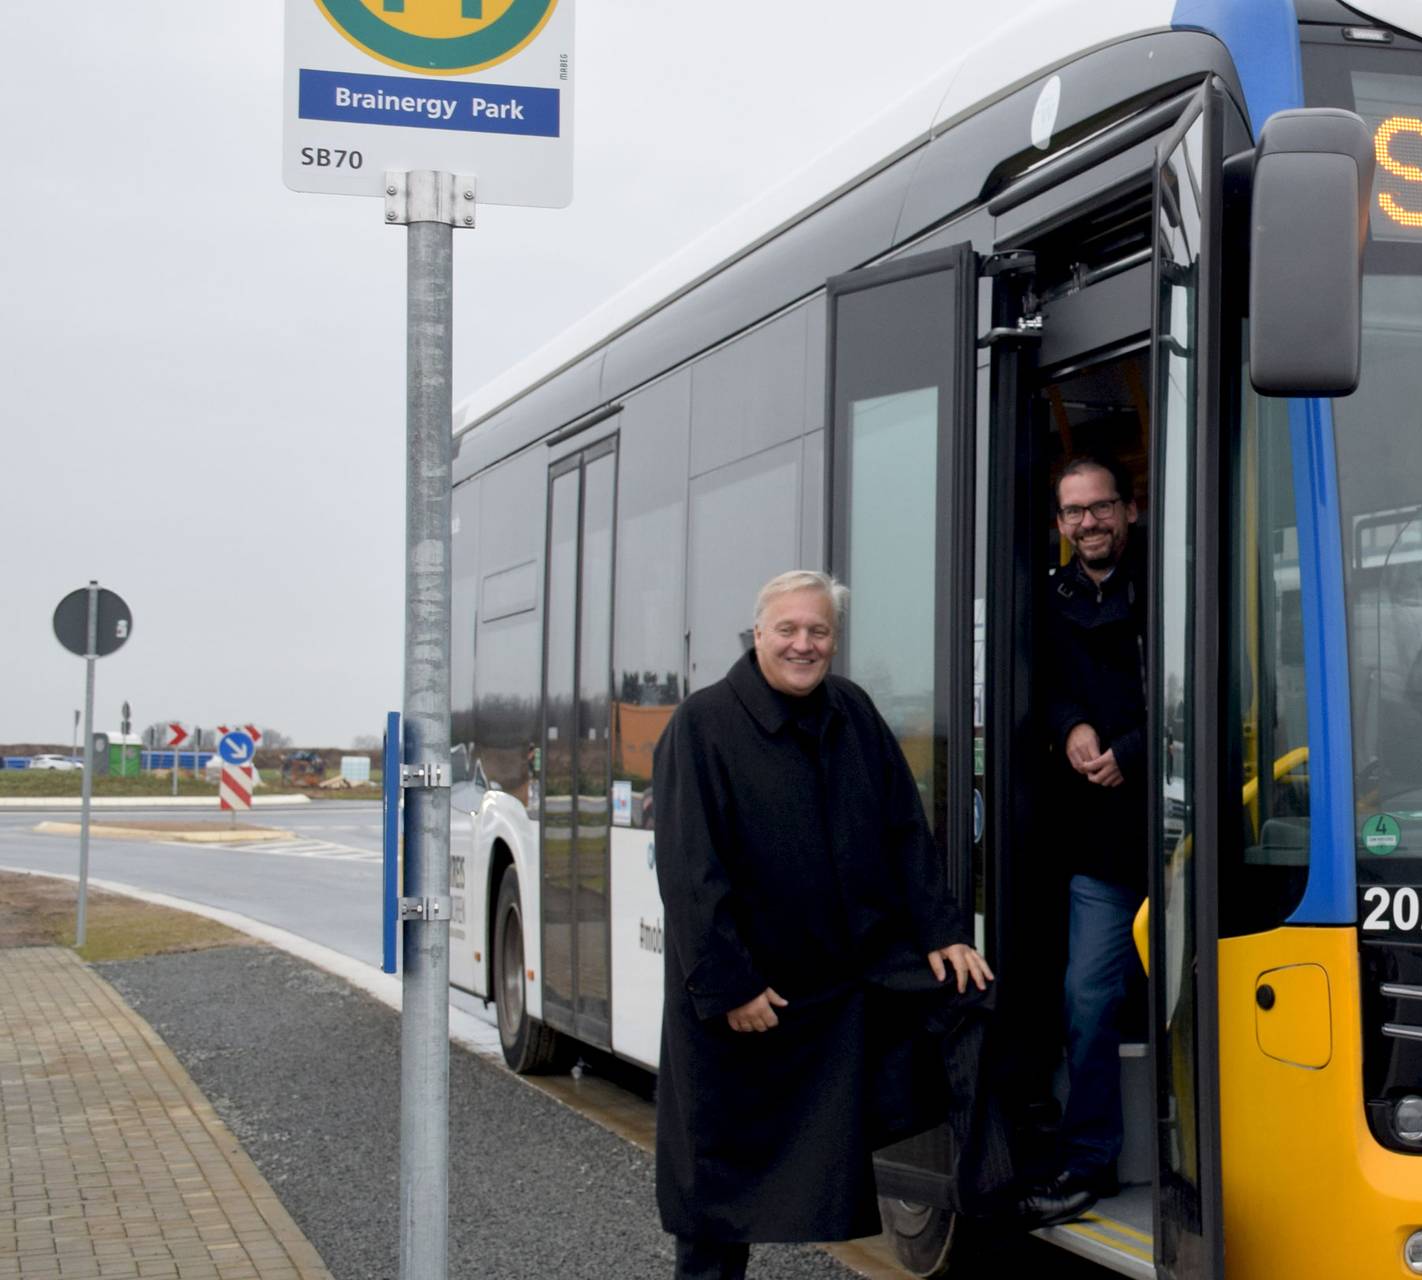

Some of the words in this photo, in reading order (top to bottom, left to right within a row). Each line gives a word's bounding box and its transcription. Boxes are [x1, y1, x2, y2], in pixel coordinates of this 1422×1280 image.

[336, 86, 457, 120] Brainergy
[472, 97, 524, 120] Park
[300, 146, 363, 170] SB70
[1375, 815, 1387, 835] 4
